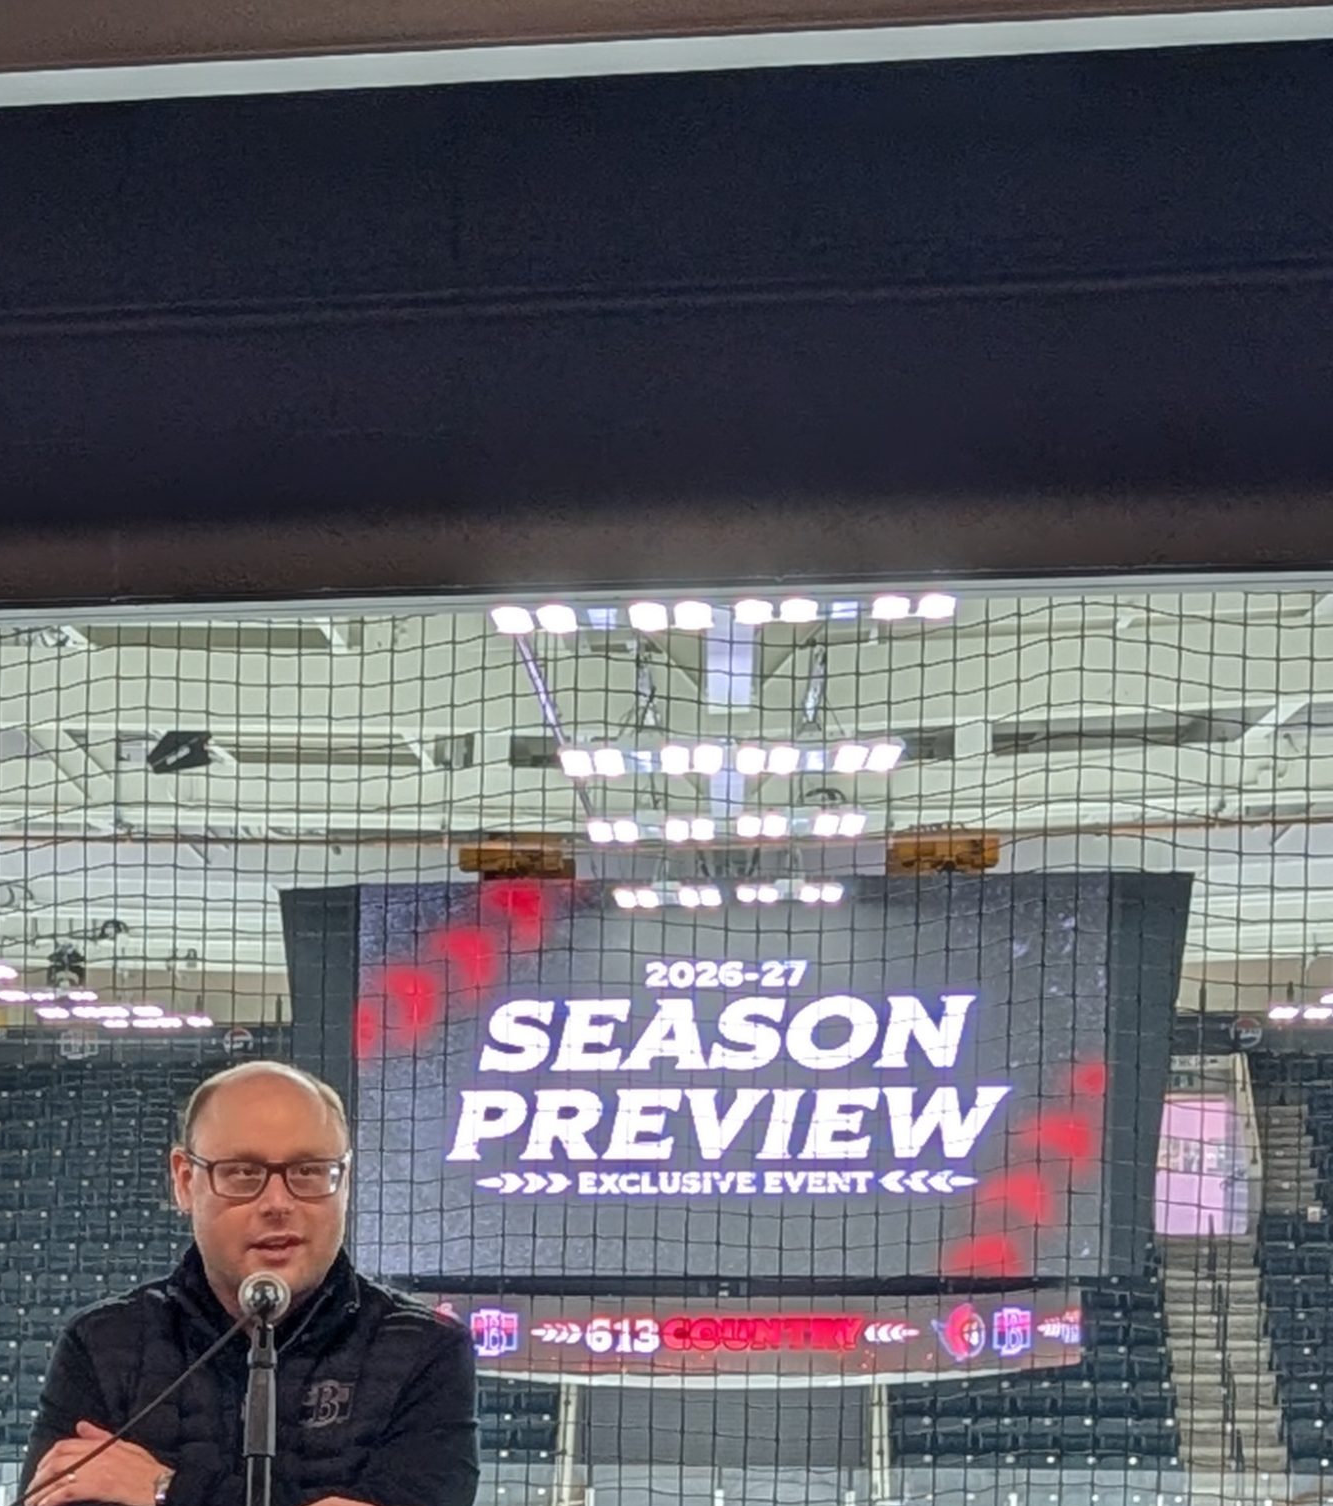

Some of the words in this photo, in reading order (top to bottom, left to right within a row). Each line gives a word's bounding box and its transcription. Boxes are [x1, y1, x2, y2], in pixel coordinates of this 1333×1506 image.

[646, 960, 807, 988] 2026-27
[479, 995, 975, 1072] SEASON
[446, 1087, 1010, 1160] PREVIEW
[579, 1172, 756, 1194] EXCLUSIVE
[764, 1171, 874, 1194] EVENT
[586, 1318, 659, 1352] 613
[663, 1317, 864, 1351] COUNTRY
